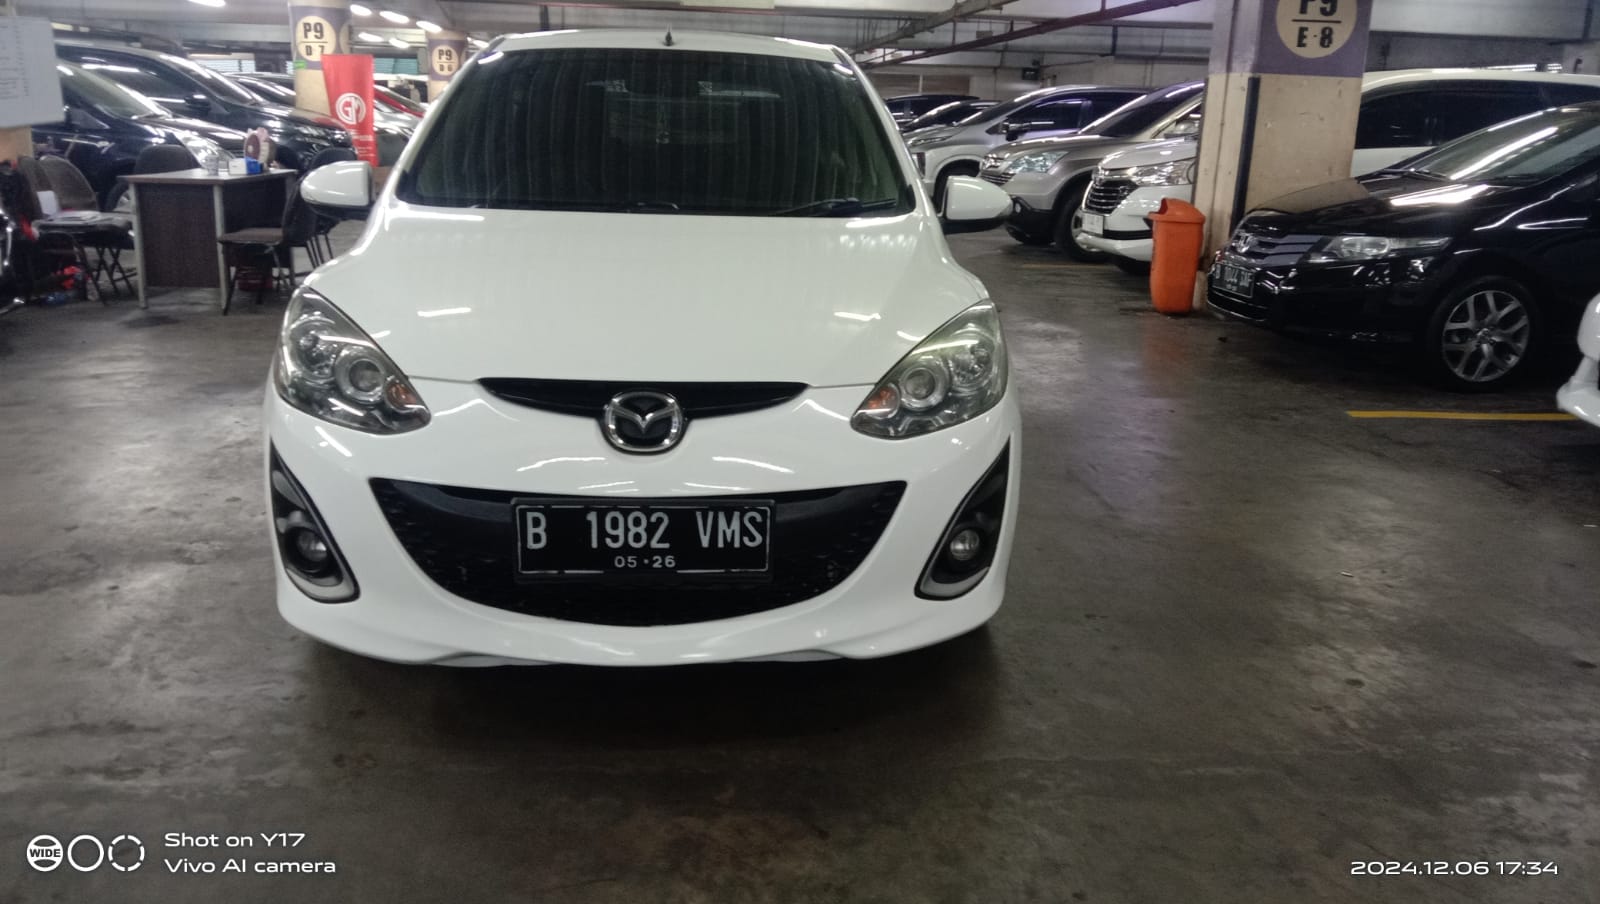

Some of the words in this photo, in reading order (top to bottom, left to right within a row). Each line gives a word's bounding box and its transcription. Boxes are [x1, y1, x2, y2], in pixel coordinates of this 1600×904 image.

[303, 22, 325, 40] P9
[438, 49, 453, 61] P9
[526, 511, 547, 550] B
[586, 511, 670, 549] 1982
[696, 511, 763, 549] VMS
